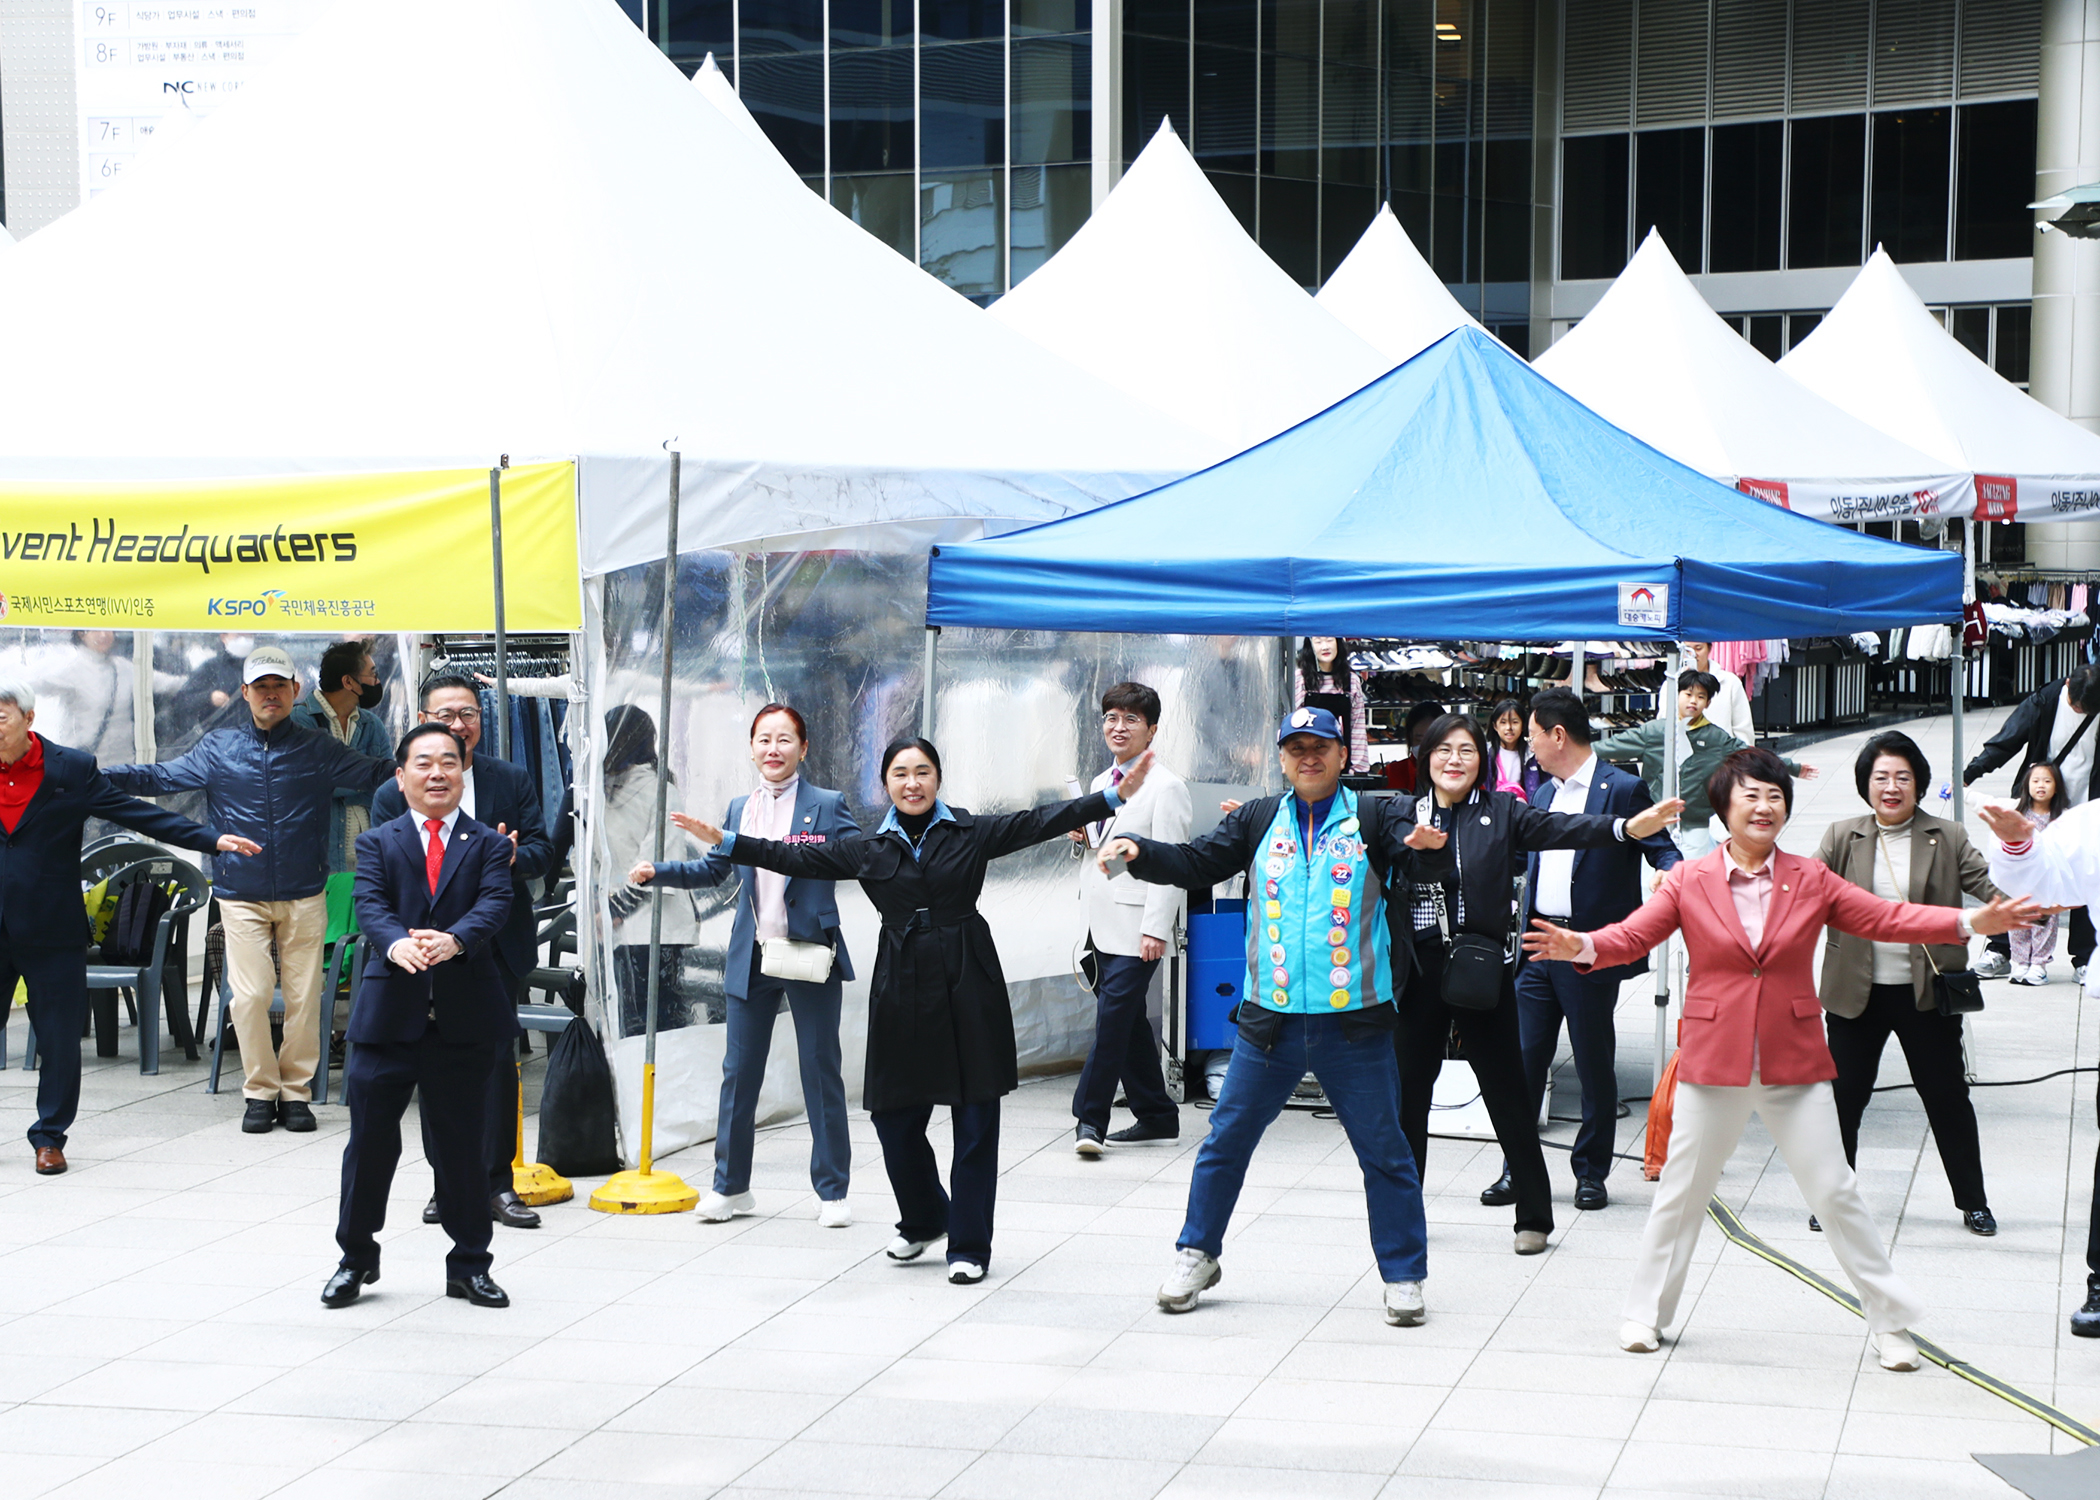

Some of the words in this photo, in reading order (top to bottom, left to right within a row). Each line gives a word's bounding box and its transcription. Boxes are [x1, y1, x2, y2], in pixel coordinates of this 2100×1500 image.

[95, 6, 117, 26] 9F
[136, 10, 160, 21] 식당가
[167, 10, 200, 20] 업무시설
[208, 9, 224, 20] 스낵
[232, 8, 256, 19] 편의점
[96, 43, 118, 63] 8F
[137, 53, 166, 62] 업무시설
[174, 52, 194, 62] 부동산
[222, 51, 244, 61] 편의점
[163, 80, 194, 94] NC
[197, 81, 217, 92] NEW
[100, 121, 120, 141] 7F
[101, 158, 122, 178] 6F
[1982, 483, 2010, 501] AMAZING
[0, 522, 83, 561] vent
[87, 518, 357, 574] Headquarters
[10, 595, 155, 618] 국제시민스포츠연맹(IVV)인증
[207, 598, 267, 617] KSPO
[280, 599, 376, 618] 국민체육진흥공단
